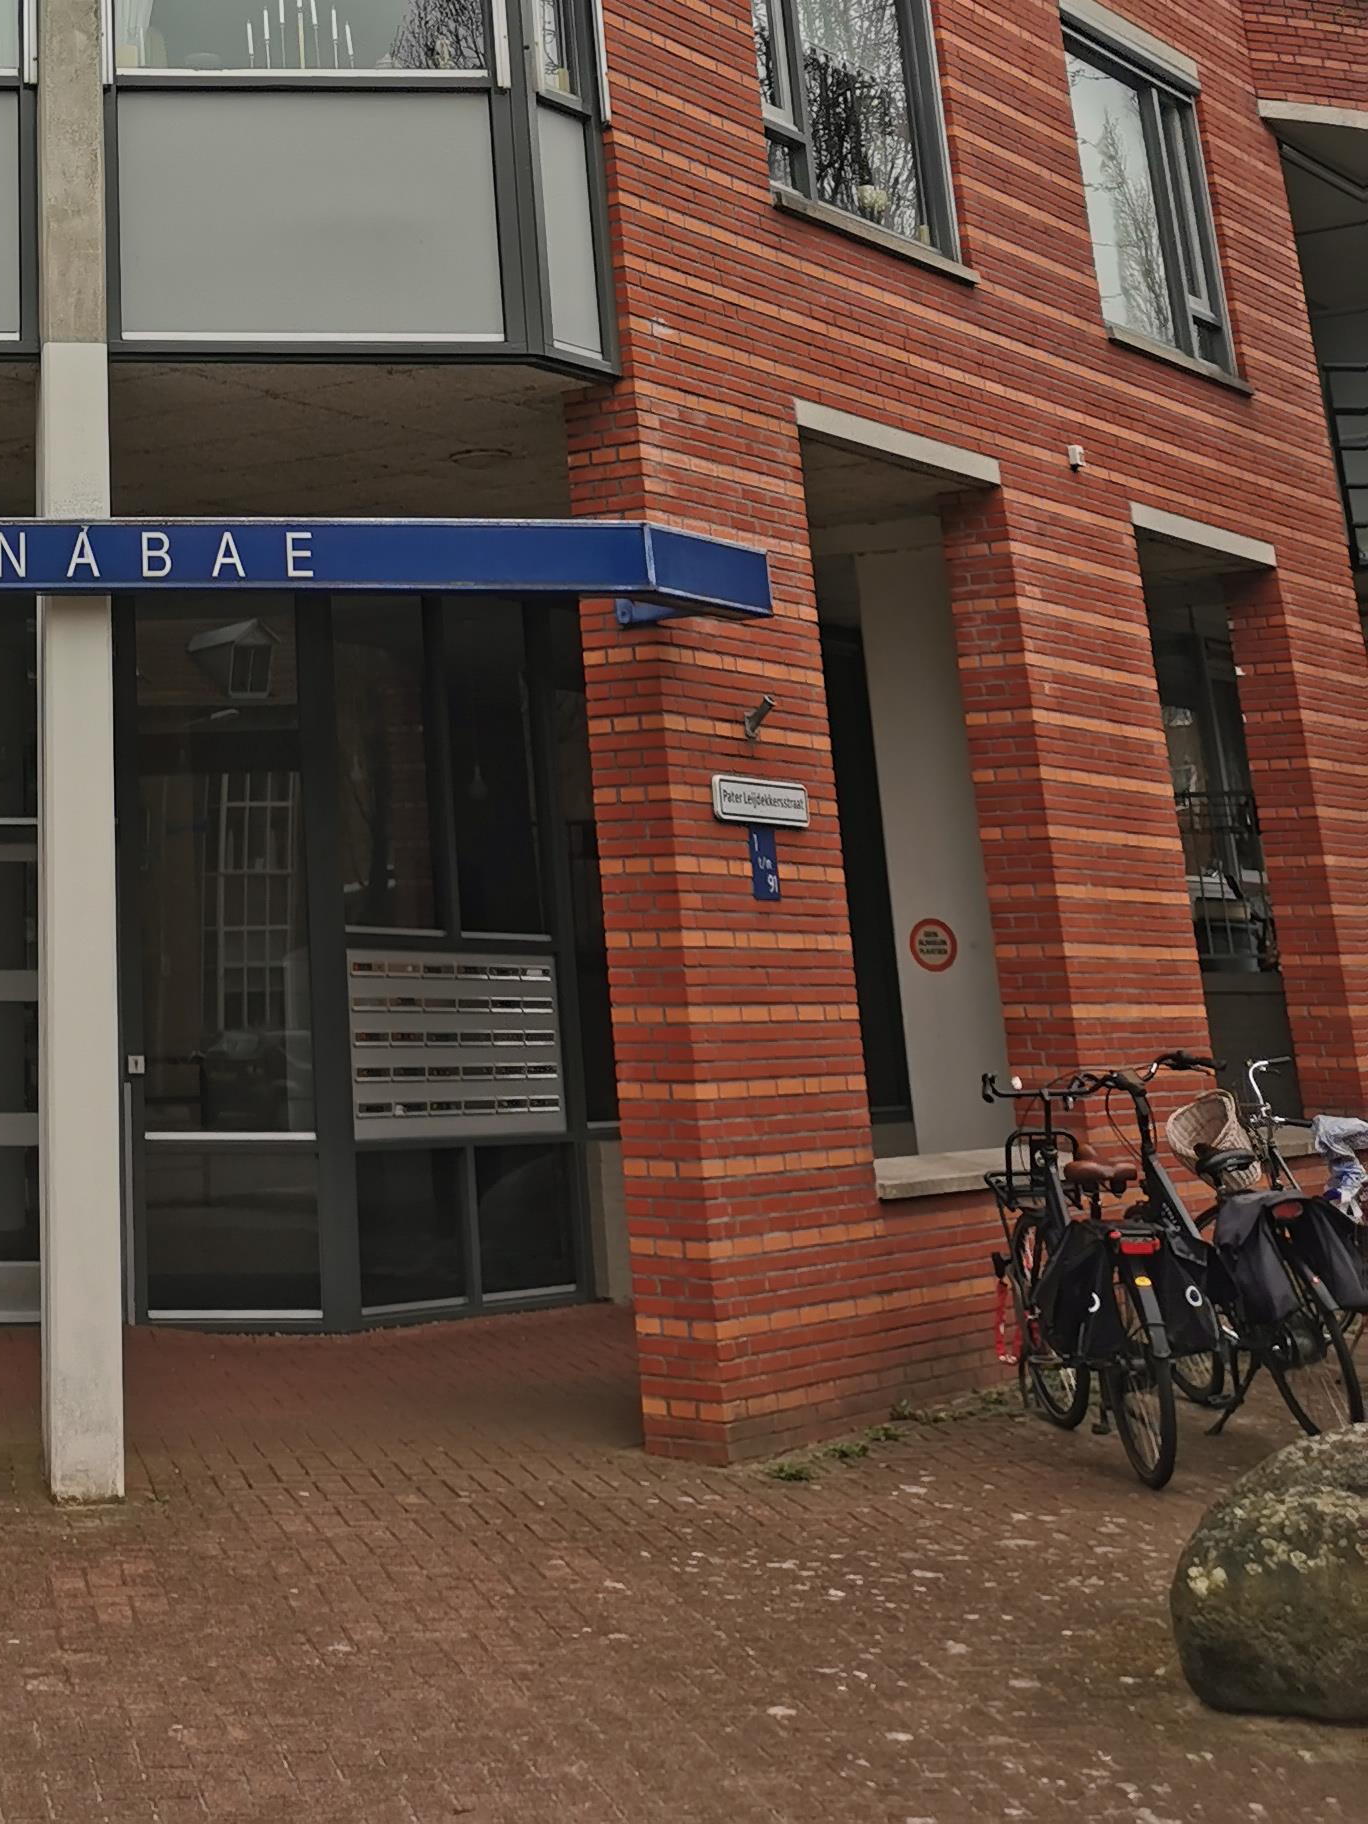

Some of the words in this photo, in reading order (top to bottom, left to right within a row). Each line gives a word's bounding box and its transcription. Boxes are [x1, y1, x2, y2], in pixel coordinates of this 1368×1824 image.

[722, 788, 743, 804] Pater
[743, 791, 805, 810] Leijdekkersstraat
[752, 833, 759, 852] 1
[767, 873, 779, 893] 91
